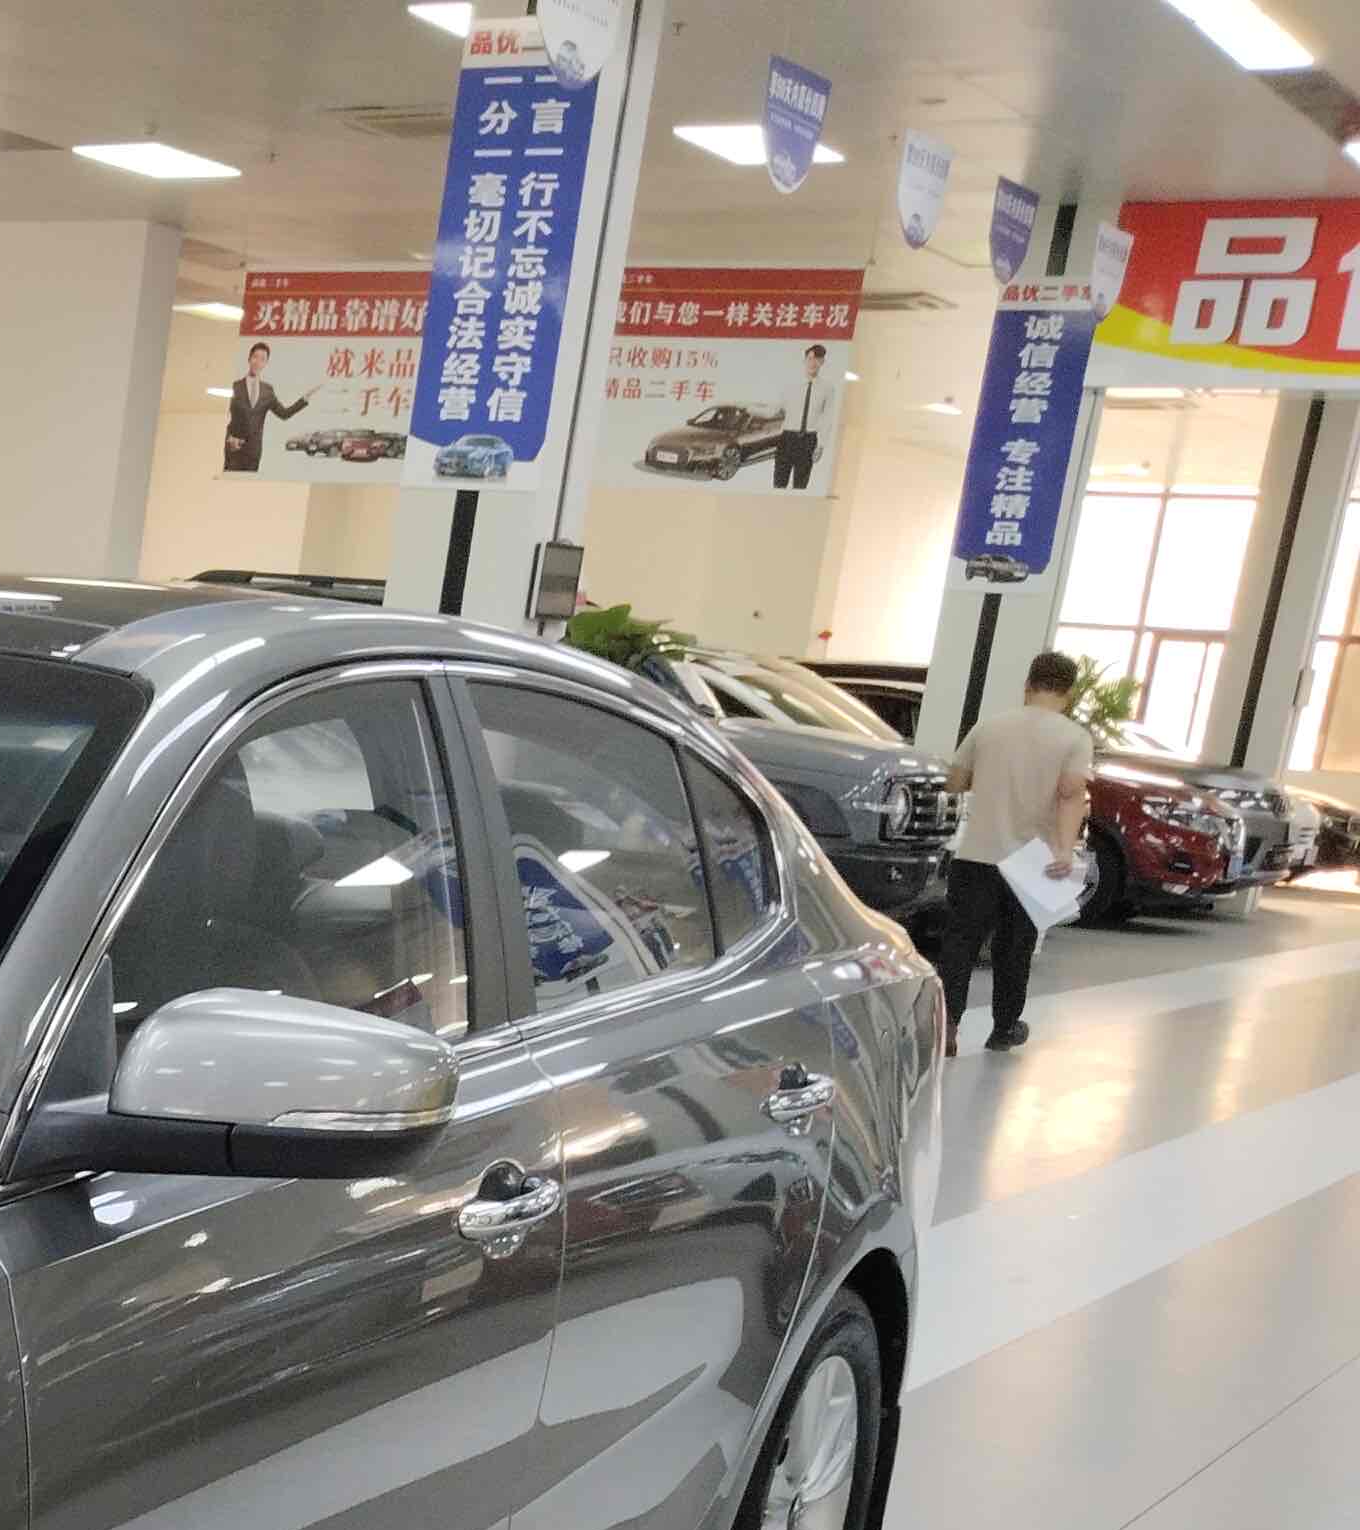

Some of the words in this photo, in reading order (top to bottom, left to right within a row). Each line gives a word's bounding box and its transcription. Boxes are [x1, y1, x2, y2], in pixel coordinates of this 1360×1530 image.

[438, 76, 523, 422] 一分一毫切记合法经营
[486, 74, 571, 423] 一言一行不忘诚实守信
[1008, 314, 1065, 425] 诚信经营
[984, 438, 1041, 546] 专注精品
